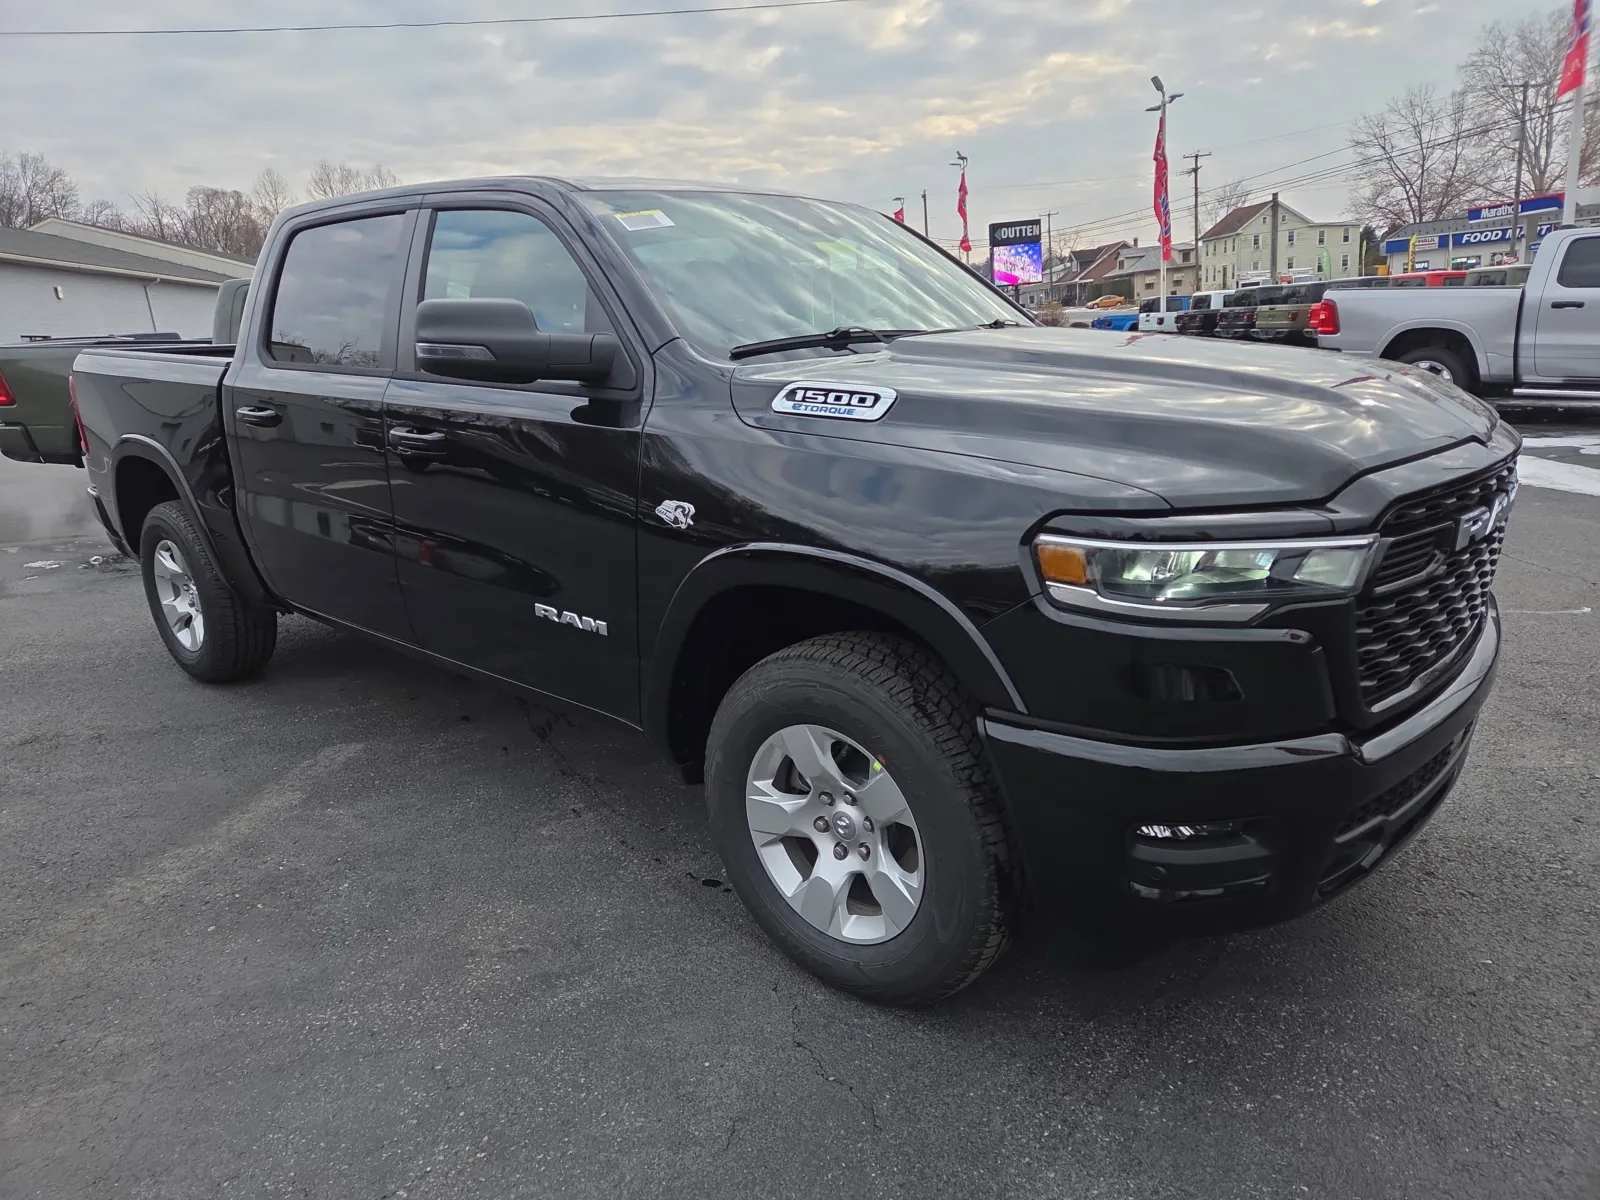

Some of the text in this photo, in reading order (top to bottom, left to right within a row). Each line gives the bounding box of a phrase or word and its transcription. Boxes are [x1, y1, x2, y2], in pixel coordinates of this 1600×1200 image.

[1001, 224, 1040, 239] OUTTEN
[1461, 230, 1503, 244] FOOD
[795, 389, 876, 407] 1500
[534, 602, 609, 637] RAM
